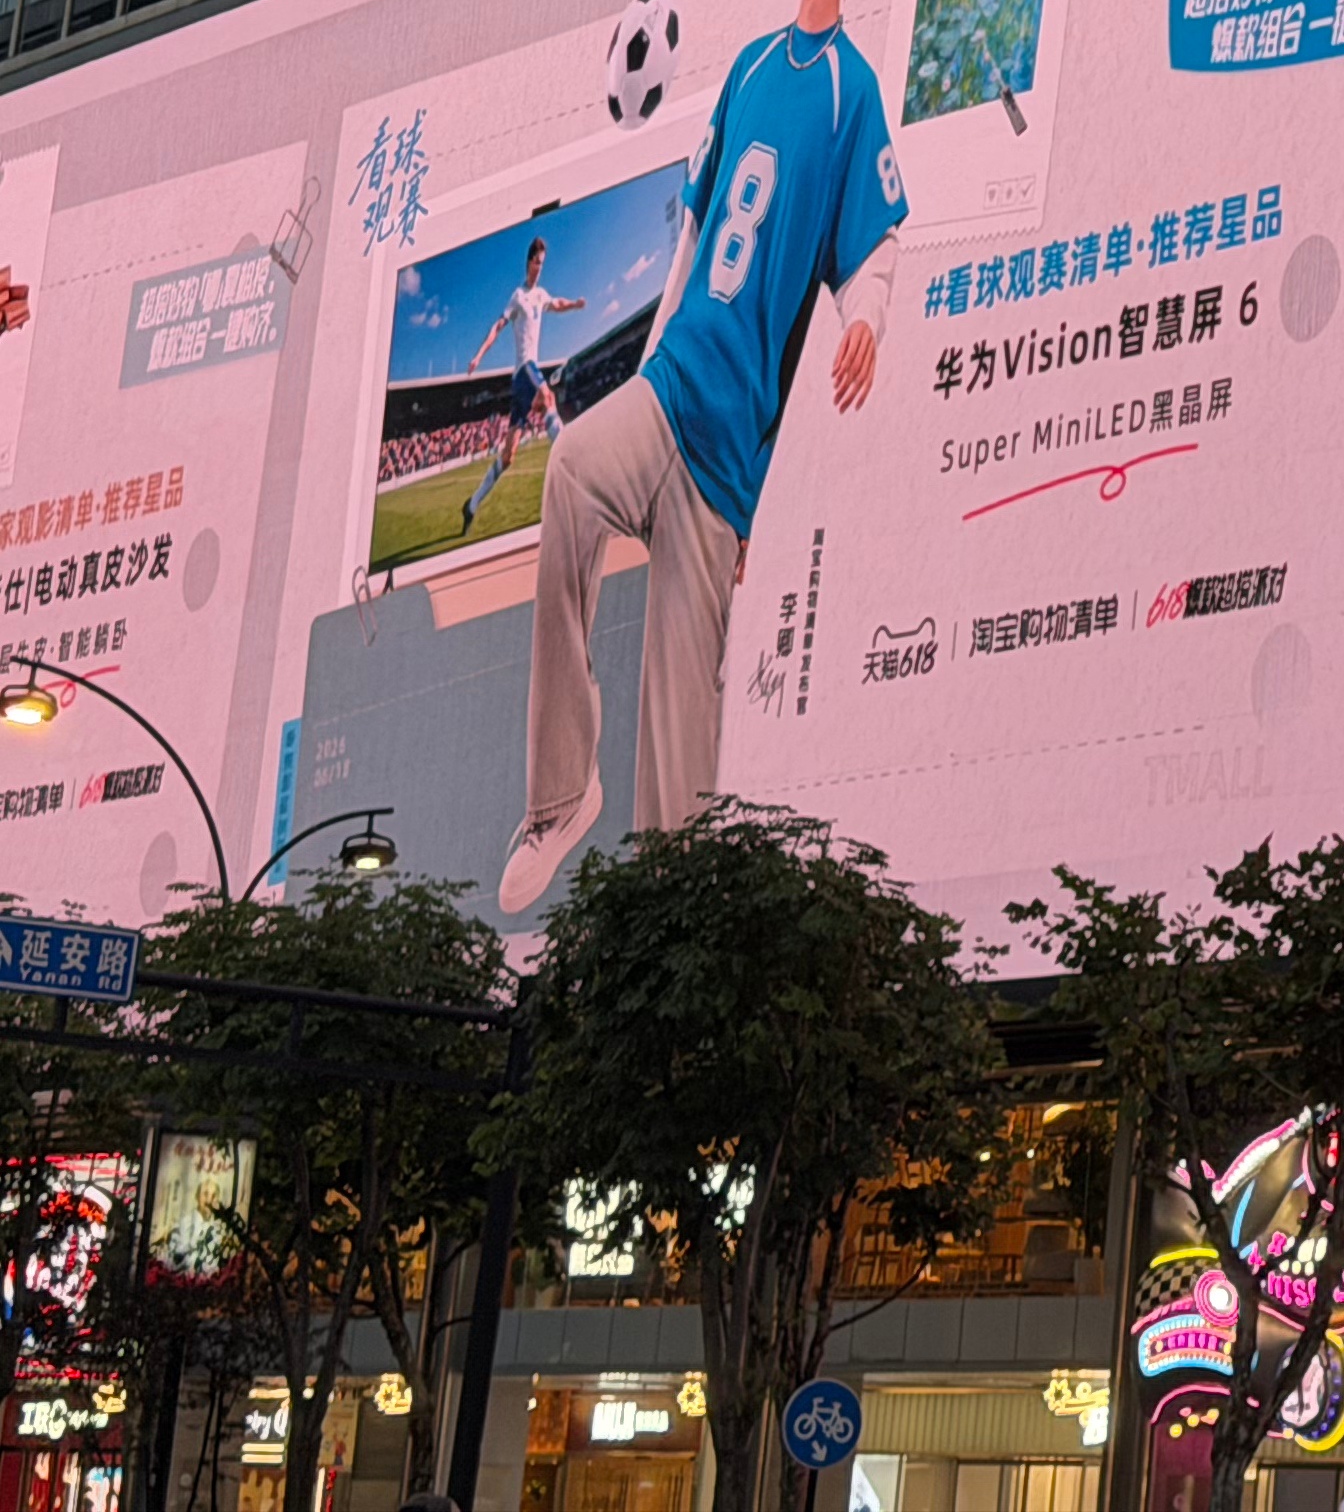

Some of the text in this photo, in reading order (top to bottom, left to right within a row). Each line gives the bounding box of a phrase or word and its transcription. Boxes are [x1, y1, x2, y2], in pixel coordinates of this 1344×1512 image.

[708, 140, 778, 304] 8
[931, 280, 1260, 402] 华为Vision智慧屏 6
[940, 376, 1234, 475] Super MiniLED黑晶屏
[861, 639, 939, 685] 天猫618
[968, 593, 1119, 658] 淘宝购物清单
[20, 928, 129, 976] 延安路
